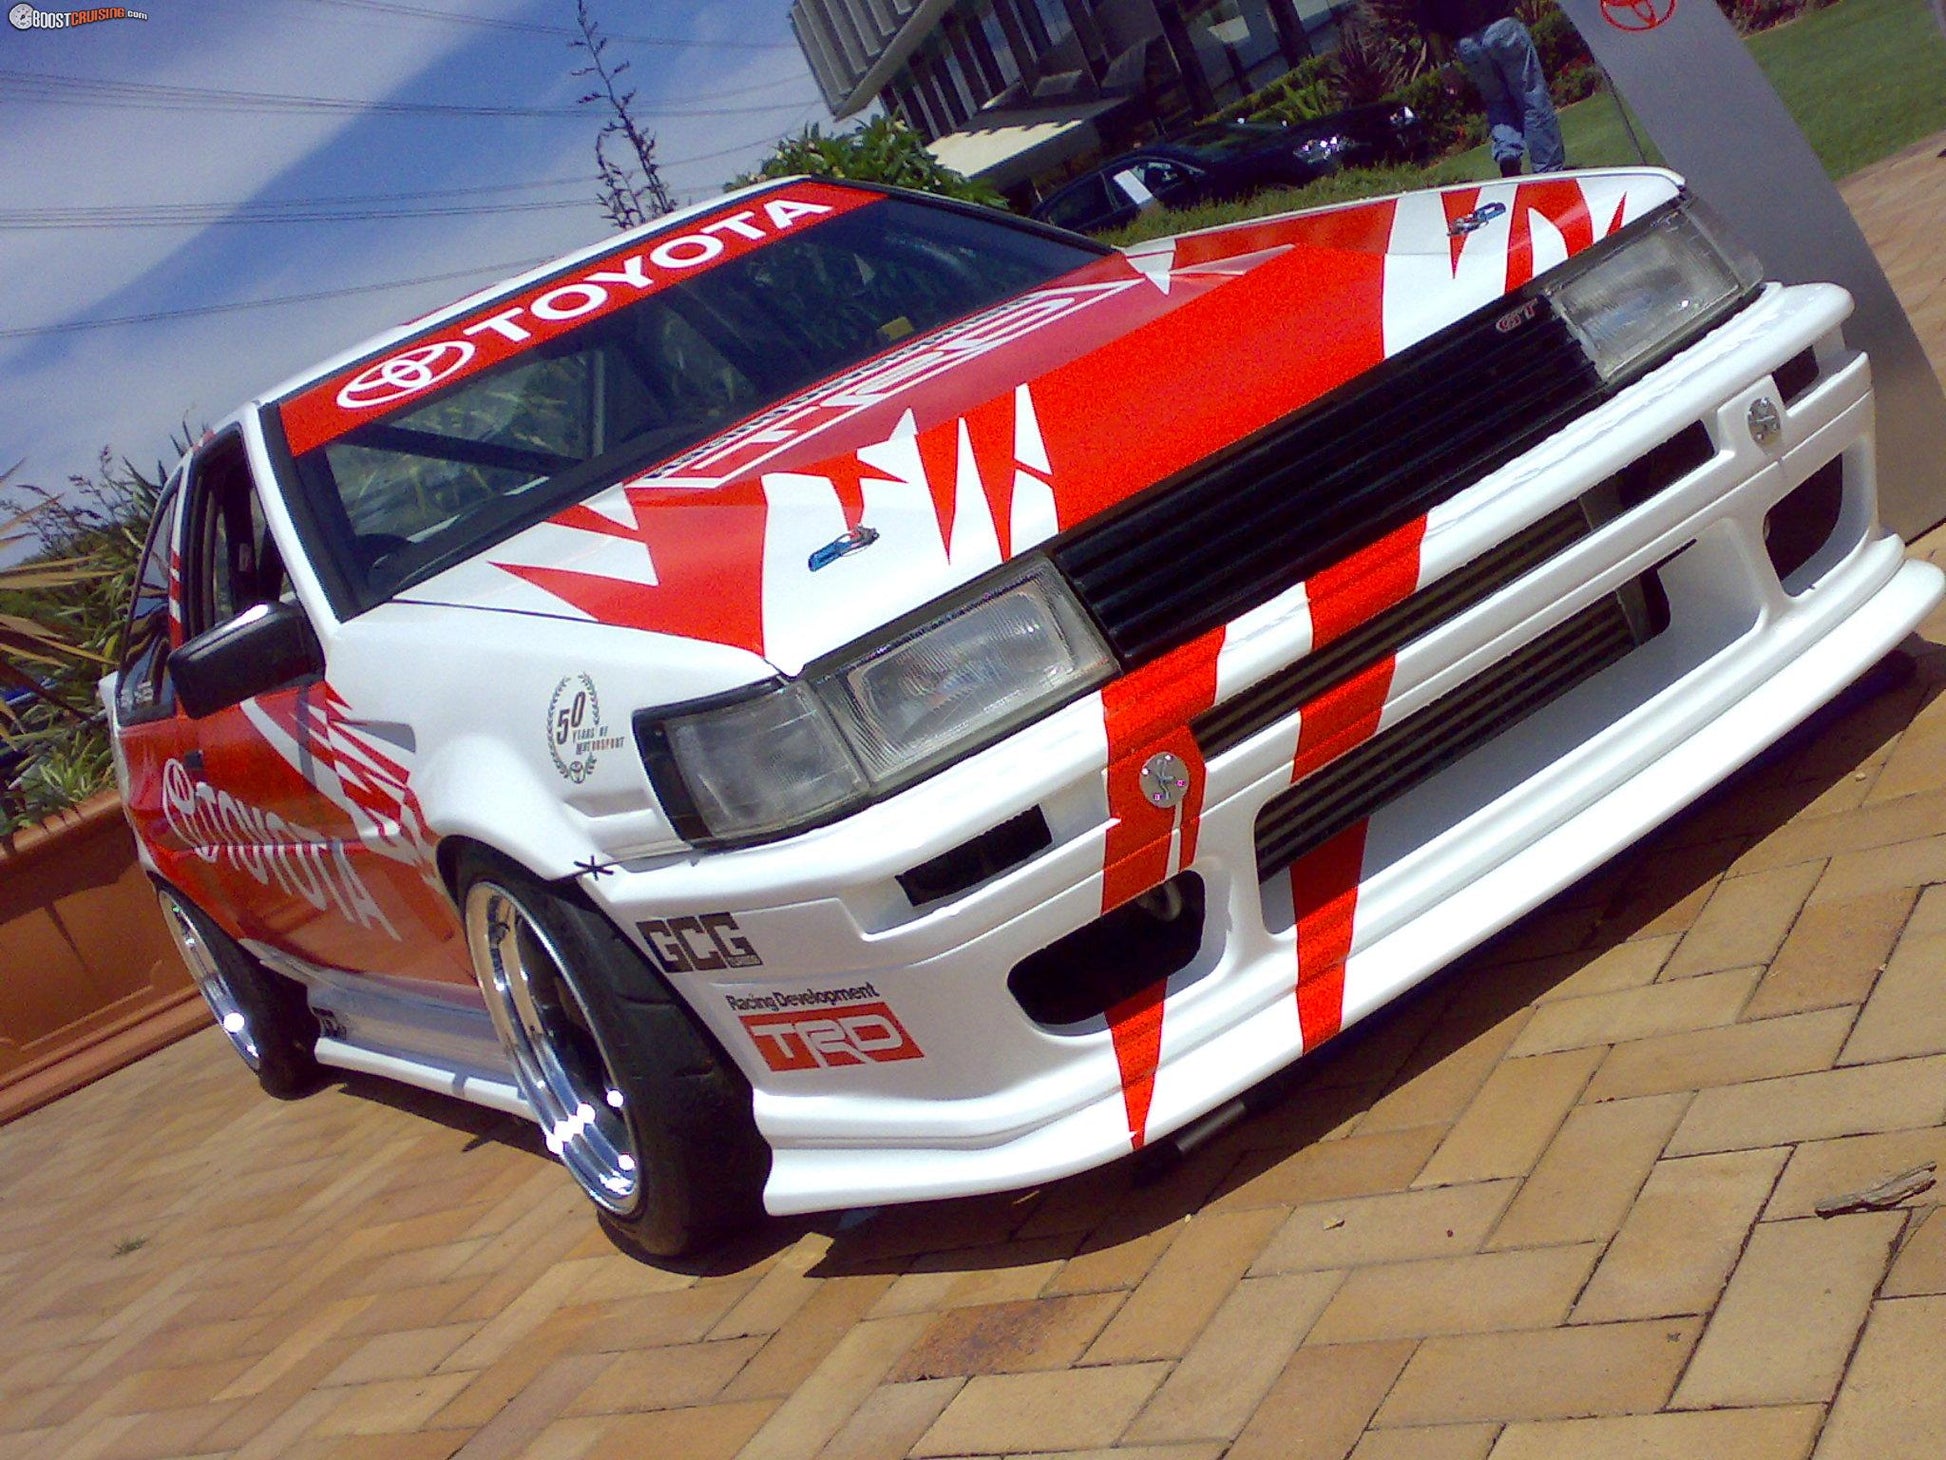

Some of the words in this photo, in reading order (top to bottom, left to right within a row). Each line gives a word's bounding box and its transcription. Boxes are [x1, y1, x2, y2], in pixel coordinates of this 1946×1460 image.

[464, 198, 835, 342] TOYOTA
[1495, 297, 1538, 333] GT
[556, 691, 586, 745] 50
[196, 781, 402, 942] TOYOTA
[636, 912, 763, 973] GCG
[725, 992, 780, 1011] Racing
[772, 981, 880, 1006] Development
[750, 1013, 905, 1068] TRD
